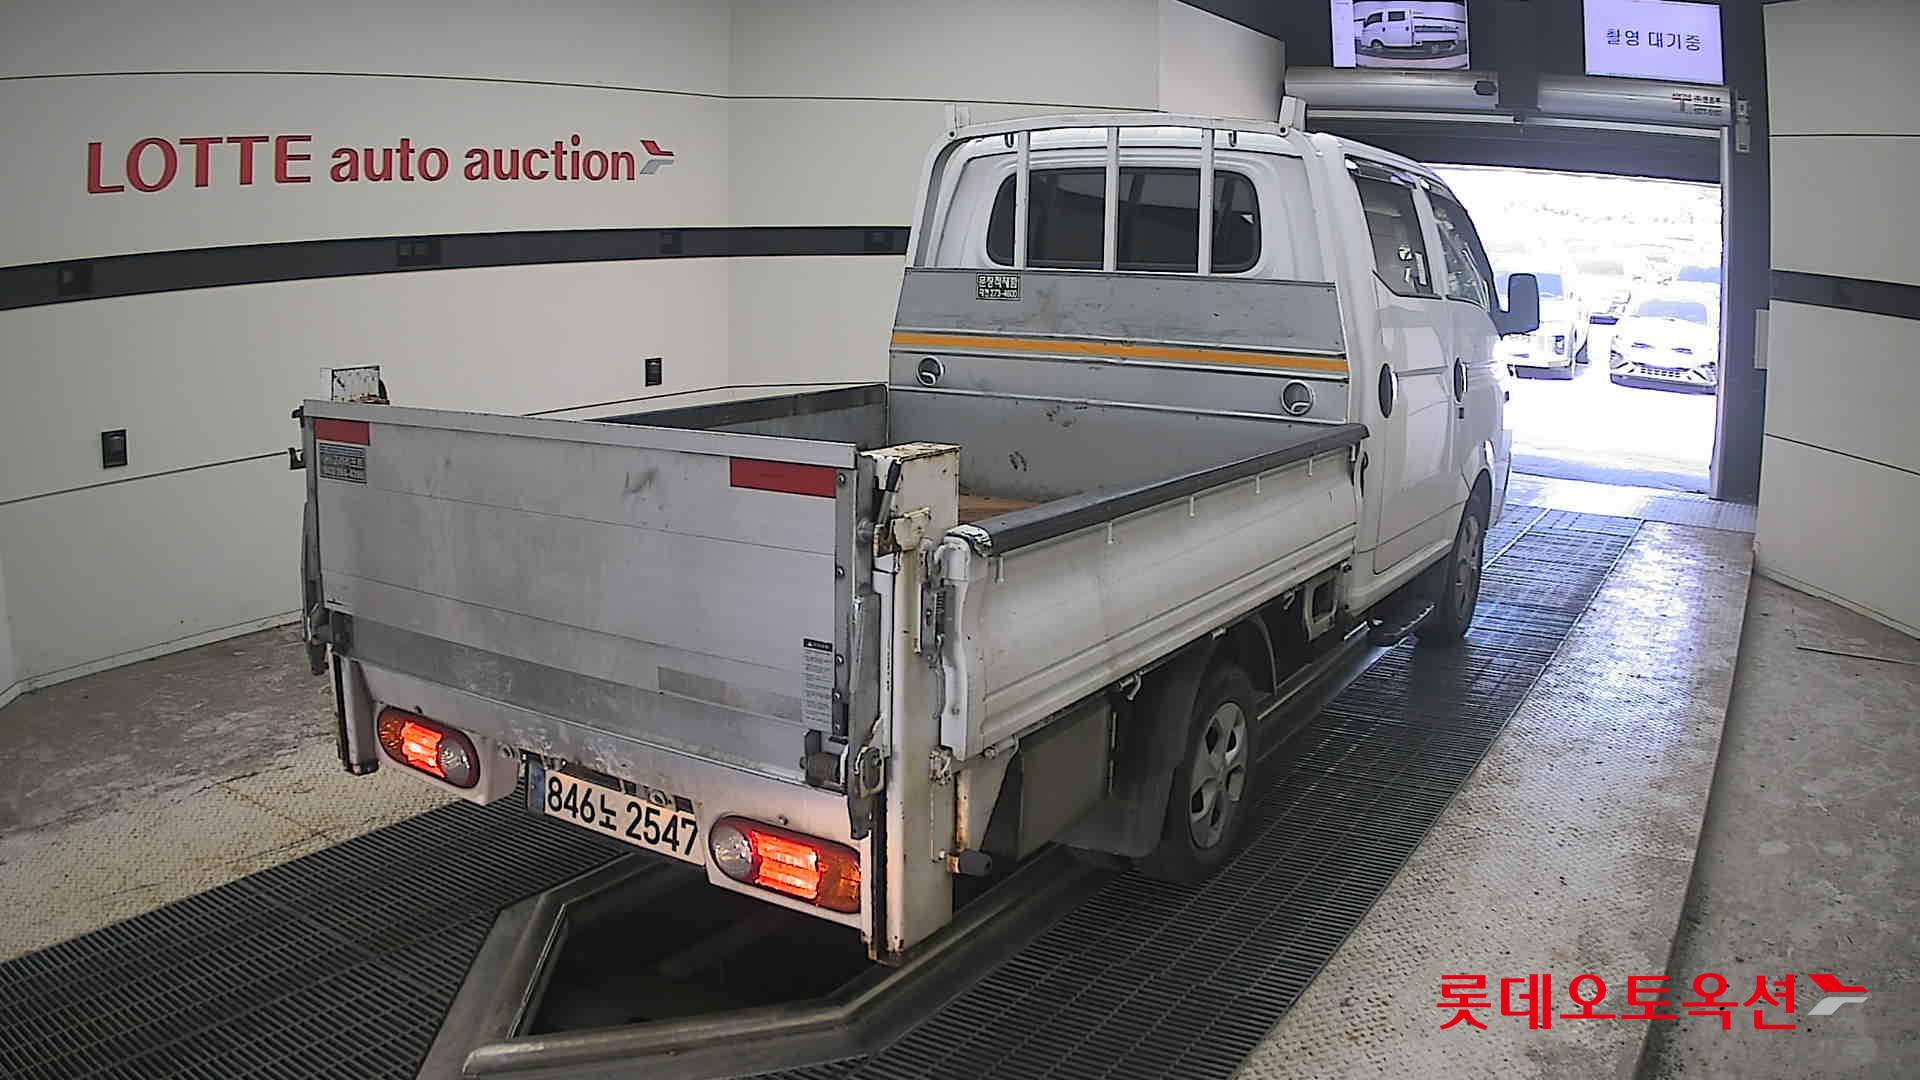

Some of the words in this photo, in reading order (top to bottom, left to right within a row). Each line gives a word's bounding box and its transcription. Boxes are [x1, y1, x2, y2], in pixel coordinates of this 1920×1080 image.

[1606, 27, 1640, 47] 촬영
[1648, 31, 1701, 51] 대기중
[87, 135, 312, 194] LOTTE
[330, 138, 450, 184] auto
[463, 134, 638, 183] auction
[547, 775, 617, 832] 846노
[625, 800, 699, 857] 2547
